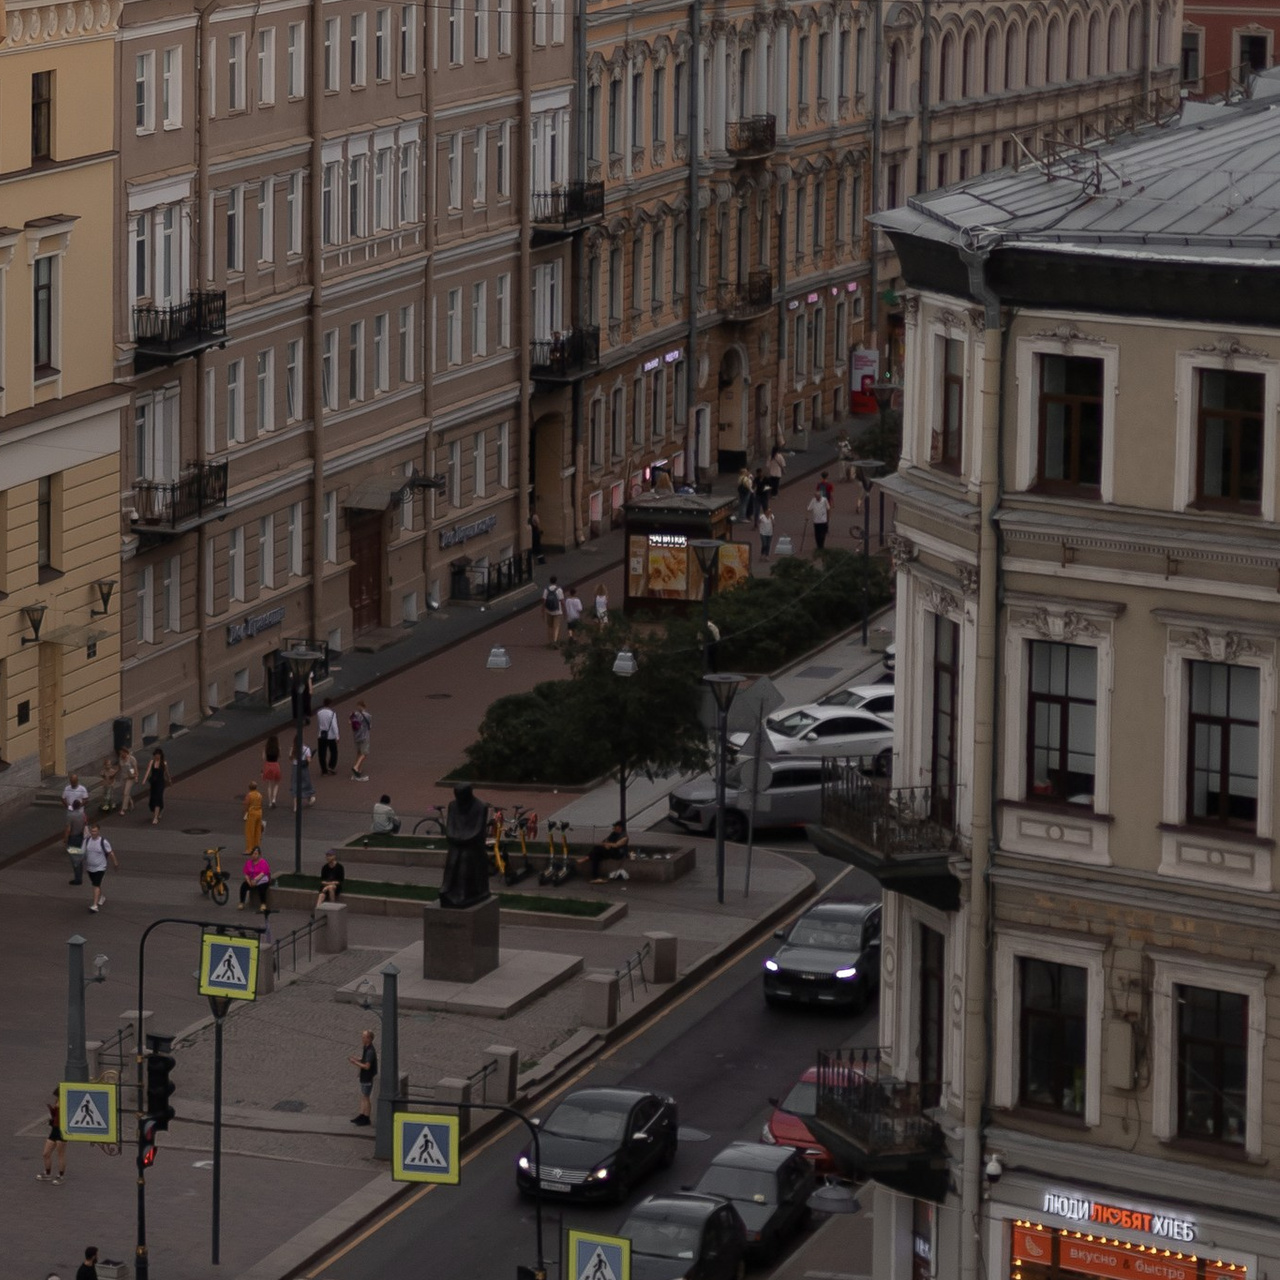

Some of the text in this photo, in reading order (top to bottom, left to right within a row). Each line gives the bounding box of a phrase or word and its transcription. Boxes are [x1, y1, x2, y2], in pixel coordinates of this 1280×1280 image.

[1042, 1193, 1090, 1221] ЛЮДИ
[1151, 1214, 1196, 1242] ХЛЕБ
[1070, 1248, 1118, 1268] вкусно
[1134, 1259, 1186, 1280] быстро
